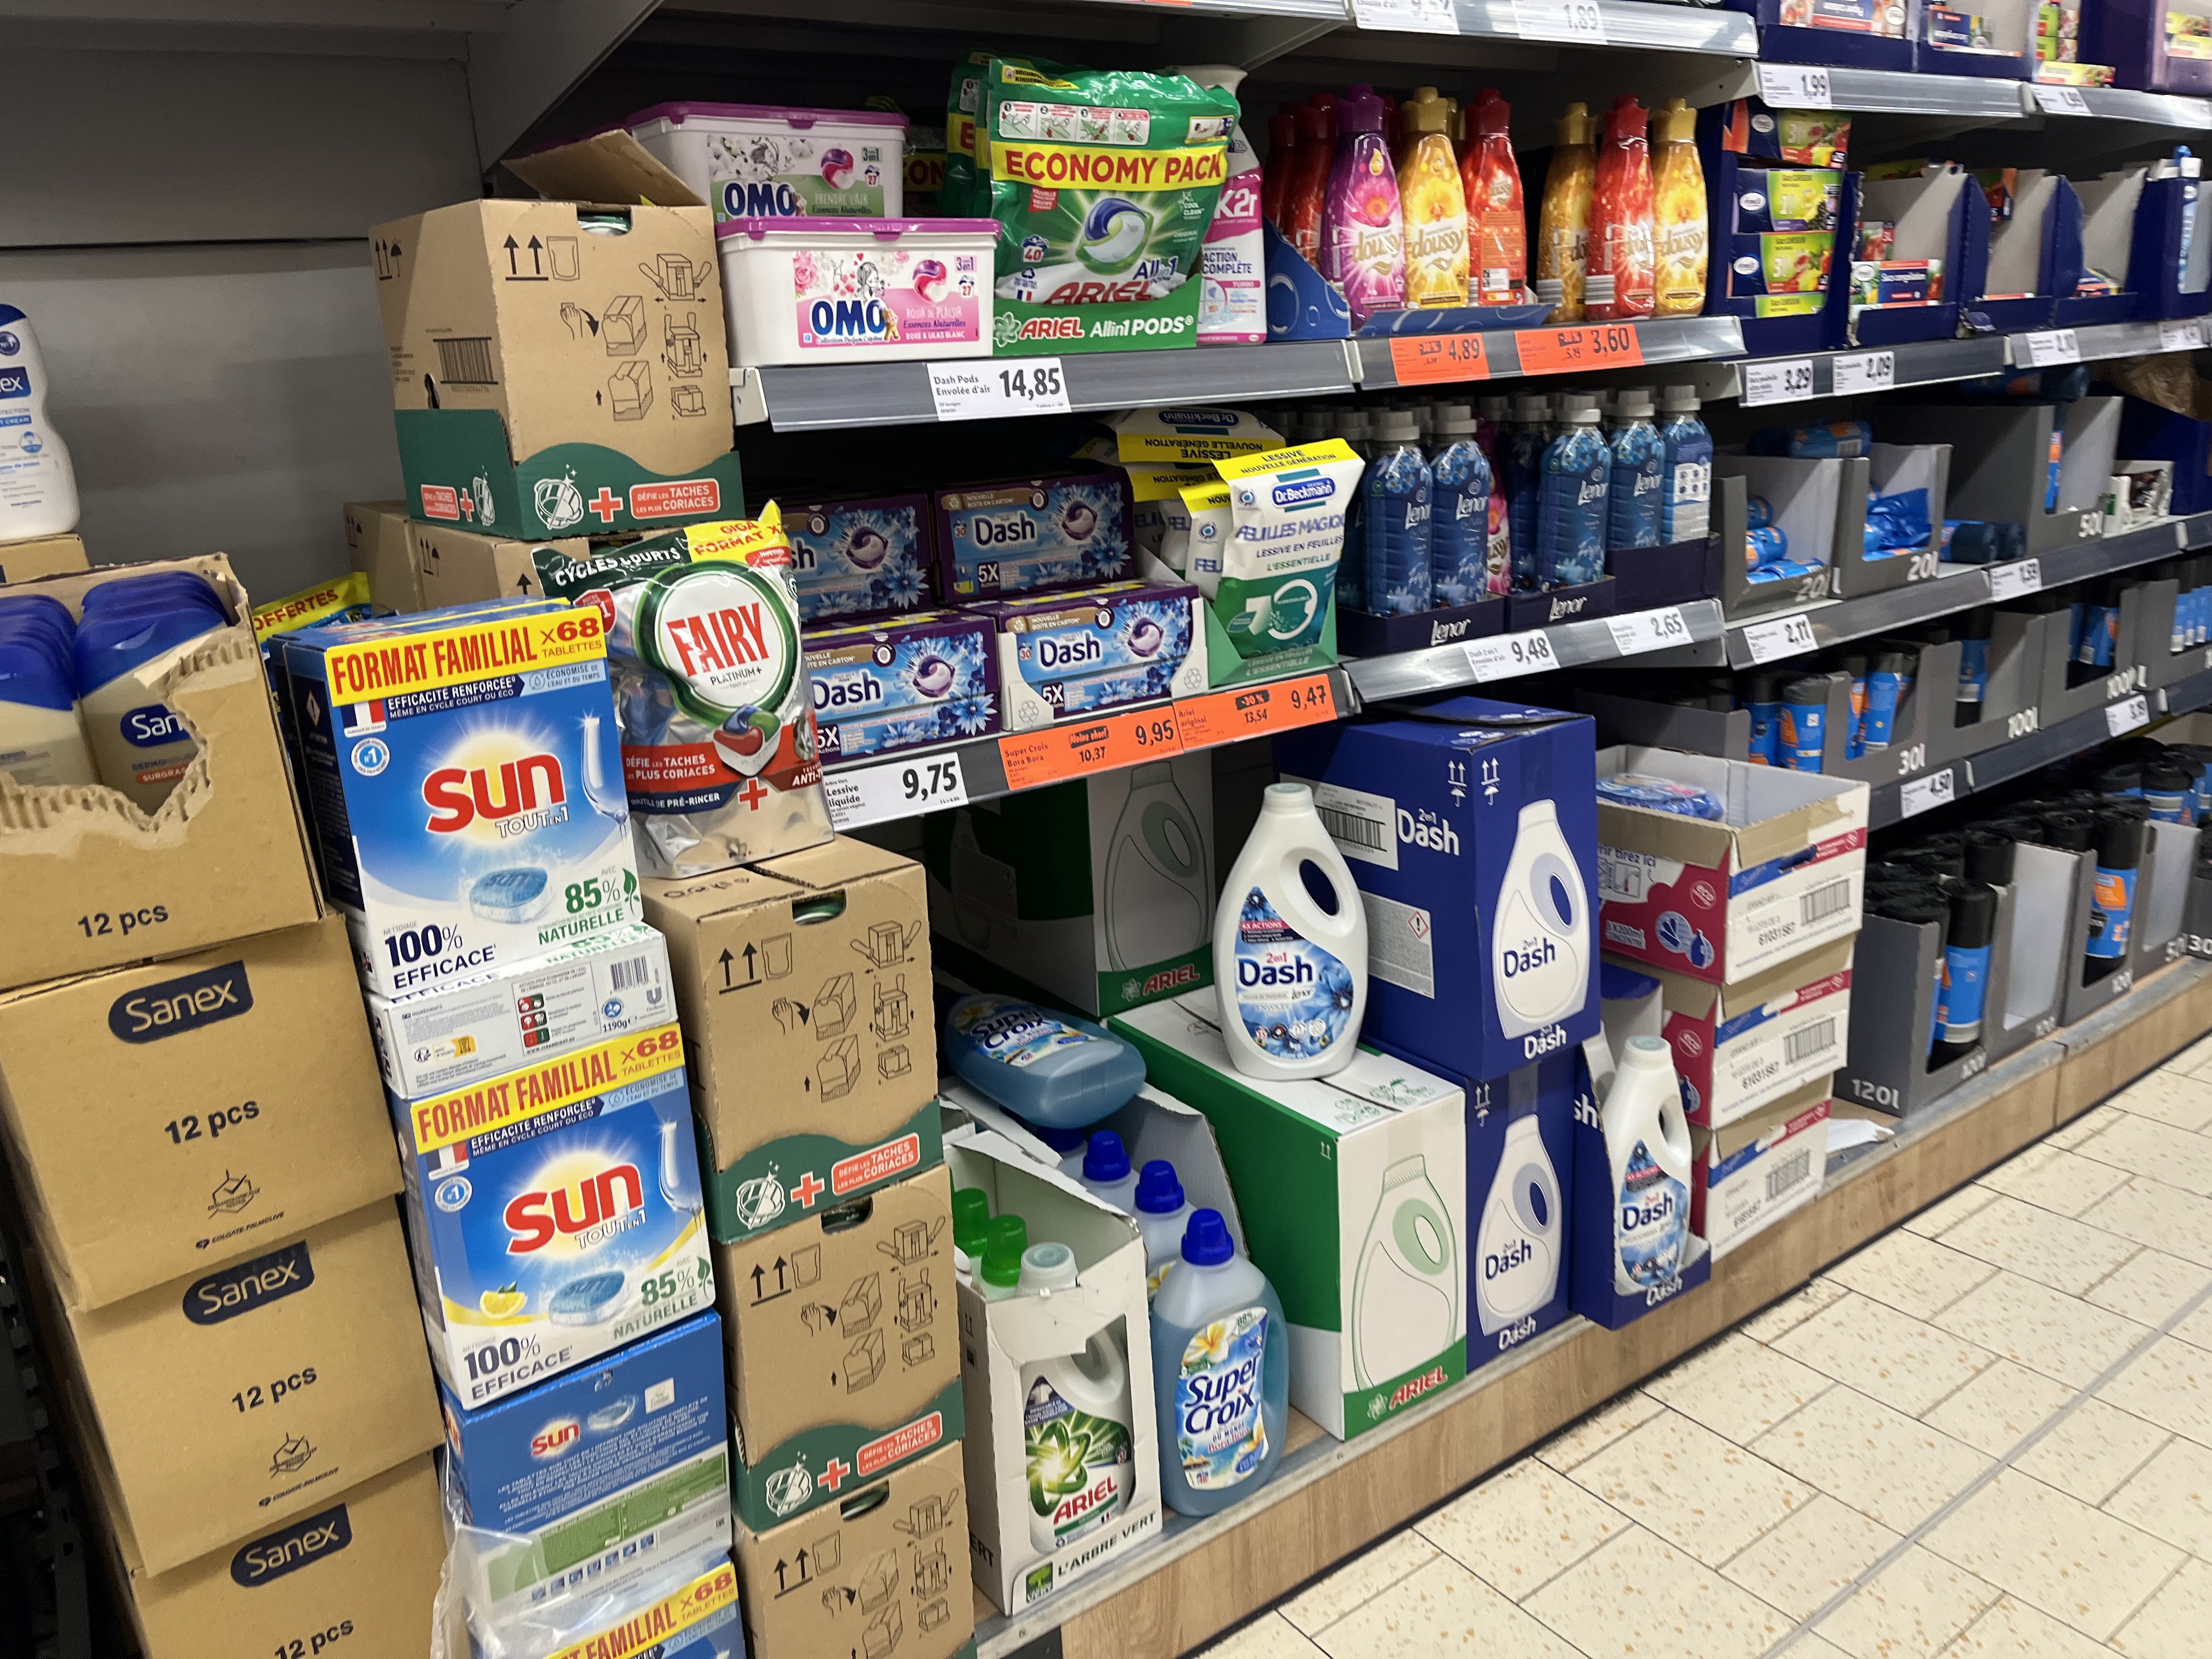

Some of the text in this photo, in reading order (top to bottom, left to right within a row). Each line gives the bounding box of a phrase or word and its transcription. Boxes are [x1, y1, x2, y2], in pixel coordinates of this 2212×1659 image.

[868, 176, 877, 185] 27
[1006, 150, 1221, 183] ECONOMY PACK
[725, 183, 796, 217] OMO
[1025, 250, 1041, 261] 40
[962, 286, 971, 296] 27
[1045, 281, 1156, 305] ARIEL
[812, 300, 886, 336] OMO
[1020, 318, 1085, 338] ARIEL
[1449, 338, 1480, 363] 4,89
[1592, 328, 1629, 357] 3,60
[934, 375, 979, 385] Dash Pods
[936, 385, 990, 396] Envolée d'air
[999, 367, 1060, 400] 14,85
[1181, 449, 1231, 459] LESSIVE
[1211, 440, 1263, 452] NOUVELLE
[1262, 450, 1305, 462] LESSIVE
[1241, 453, 1337, 474] NOUVELLE GÉNÉRATION
[637, 491, 657, 501] DÉFIE
[669, 484, 710, 498] TACHES
[648, 504, 662, 512] PLUS
[663, 496, 714, 510] CORIACES
[720, 521, 759, 535] GIGA
[955, 527, 967, 537] 30
[974, 509, 1035, 545] Dash
[694, 532, 763, 556] FORMAT
[556, 556, 618, 586] CYCLES
[978, 564, 999, 583] 5X
[254, 588, 340, 631] OFFERTES
[1550, 596, 1587, 622] Lenor
[665, 602, 770, 677] FAIRY
[1431, 617, 1471, 646] Lenor
[1651, 613, 1683, 639] 2,65
[331, 626, 538, 696] FORMAT FAMILIAL
[540, 639, 602, 660] TABLETTES
[1021, 650, 1032, 659] 30
[1039, 632, 1100, 667] Dash
[1511, 637, 1550, 665] 9,48
[546, 664, 589, 679] ÉCONOMISE
[564, 678, 572, 686] ET
[573, 676, 581, 684] DU
[582, 672, 601, 682] TEMPS
[388, 686, 449, 711] EFFICACITÉ
[390, 688, 515, 719] MÊME EN CYCLE COURT OU ÉCO
[814, 672, 881, 710] Dash
[1042, 685, 1064, 704] 5X
[1291, 684, 1327, 710] 9,47
[1179, 708, 1195, 717] Ariel
[1181, 716, 1207, 727] original
[1244, 708, 1268, 725] 13,54
[1135, 719, 1174, 747] 9,95
[625, 754, 706, 768] DÉFIE TACHES
[1005, 742, 1048, 758] Super Croix
[1007, 754, 1045, 768] Bora Bora
[1080, 746, 1106, 764] 10,37
[635, 764, 715, 780] PLUS CORIACES
[902, 760, 957, 802] 9,75
[656, 792, 720, 808] DE PRÉ-RINCER
[826, 785, 859, 797] Lessive
[828, 795, 860, 808] liquide
[495, 810, 549, 839] TOUT
[1398, 808, 1460, 856] Dash
[601, 865, 617, 876] AVEC
[565, 877, 620, 913] 85%
[78, 904, 170, 938] 12 pcs
[538, 907, 625, 946] NATURELLE
[384, 923, 463, 968] 100%
[1503, 939, 1556, 979] Dash
[1142, 963, 1200, 996] ARIEL
[1237, 954, 1313, 987] Dash
[126, 978, 239, 1034] Sanex
[603, 1019, 628, 1032] 1190g
[984, 1017, 1052, 1051] Croix
[1523, 1025, 1567, 1059] Dash
[622, 1050, 681, 1077] TABLETTES
[417, 1050, 617, 1143] FORMAT FAMILIAL
[165, 1099, 260, 1145] 12 pcs
[471, 1119, 531, 1149] EFFICACITÉ
[499, 1139, 509, 1148] EN
[511, 1130, 535, 1143] CYCLE
[537, 1120, 563, 1134] COURT
[839, 1140, 911, 1178] DÉFIE TACHES
[864, 1150, 915, 1180] CORIACES
[1622, 1193, 1674, 1232] Dash
[575, 1219, 628, 1250] TOUT
[1485, 1239, 1532, 1281] Dash
[198, 1259, 301, 1316] Sanex
[640, 1269, 695, 1307] 85%
[613, 1295, 698, 1340] NATURELLE
[1498, 1318, 1537, 1352] Dash
[464, 1333, 541, 1381] 100%
[232, 1366, 318, 1414] 12 pcs
[1184, 1351, 1261, 1407] Super
[1389, 1365, 1449, 1410] ARIEL
[1184, 1381, 1256, 1436] Croix
[1053, 1476, 1118, 1526] ARIEL
[245, 1519, 340, 1579] Sanex
[1058, 1511, 1157, 1578] L'ARBRE VERT
[311, 1619, 354, 1656] pcs
[586, 1602, 677, 1659] FAMILIAL
